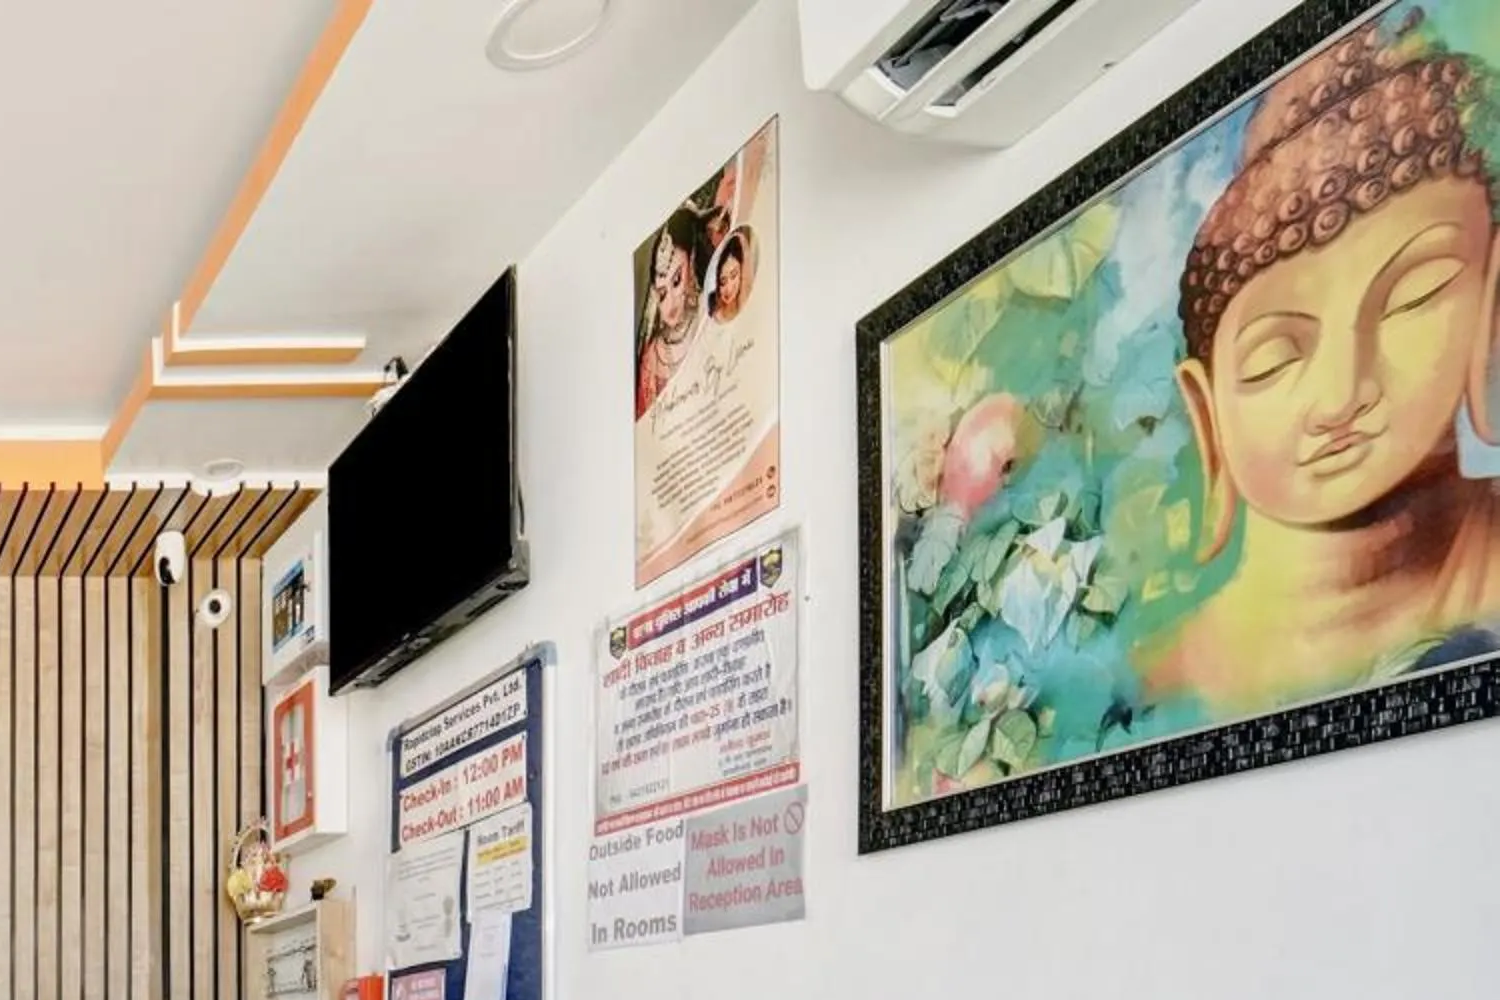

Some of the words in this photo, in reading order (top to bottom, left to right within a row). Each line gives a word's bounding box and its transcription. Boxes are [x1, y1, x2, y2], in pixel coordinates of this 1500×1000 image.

[691, 623, 726, 651] अन्य
[729, 592, 790, 632] समारोह
[443, 700, 481, 730] Services
[483, 690, 500, 709] Pvt.
[463, 754, 498, 784] 12:00
[502, 742, 523, 767] PM
[468, 786, 500, 815] 11:00
[504, 776, 523, 799] AM
[588, 834, 642, 862] Outside
[646, 820, 684, 845] Food
[690, 827, 731, 852] Mask
[733, 821, 747, 842] Is
[750, 815, 779, 837] Not
[587, 880, 614, 900] Not
[619, 861, 682, 894] Allowed
[706, 848, 765, 880] Allowed
[688, 884, 762, 912] Reception
[765, 876, 804, 902] Area
[591, 921, 607, 945] In
[613, 913, 677, 939] Rooms
